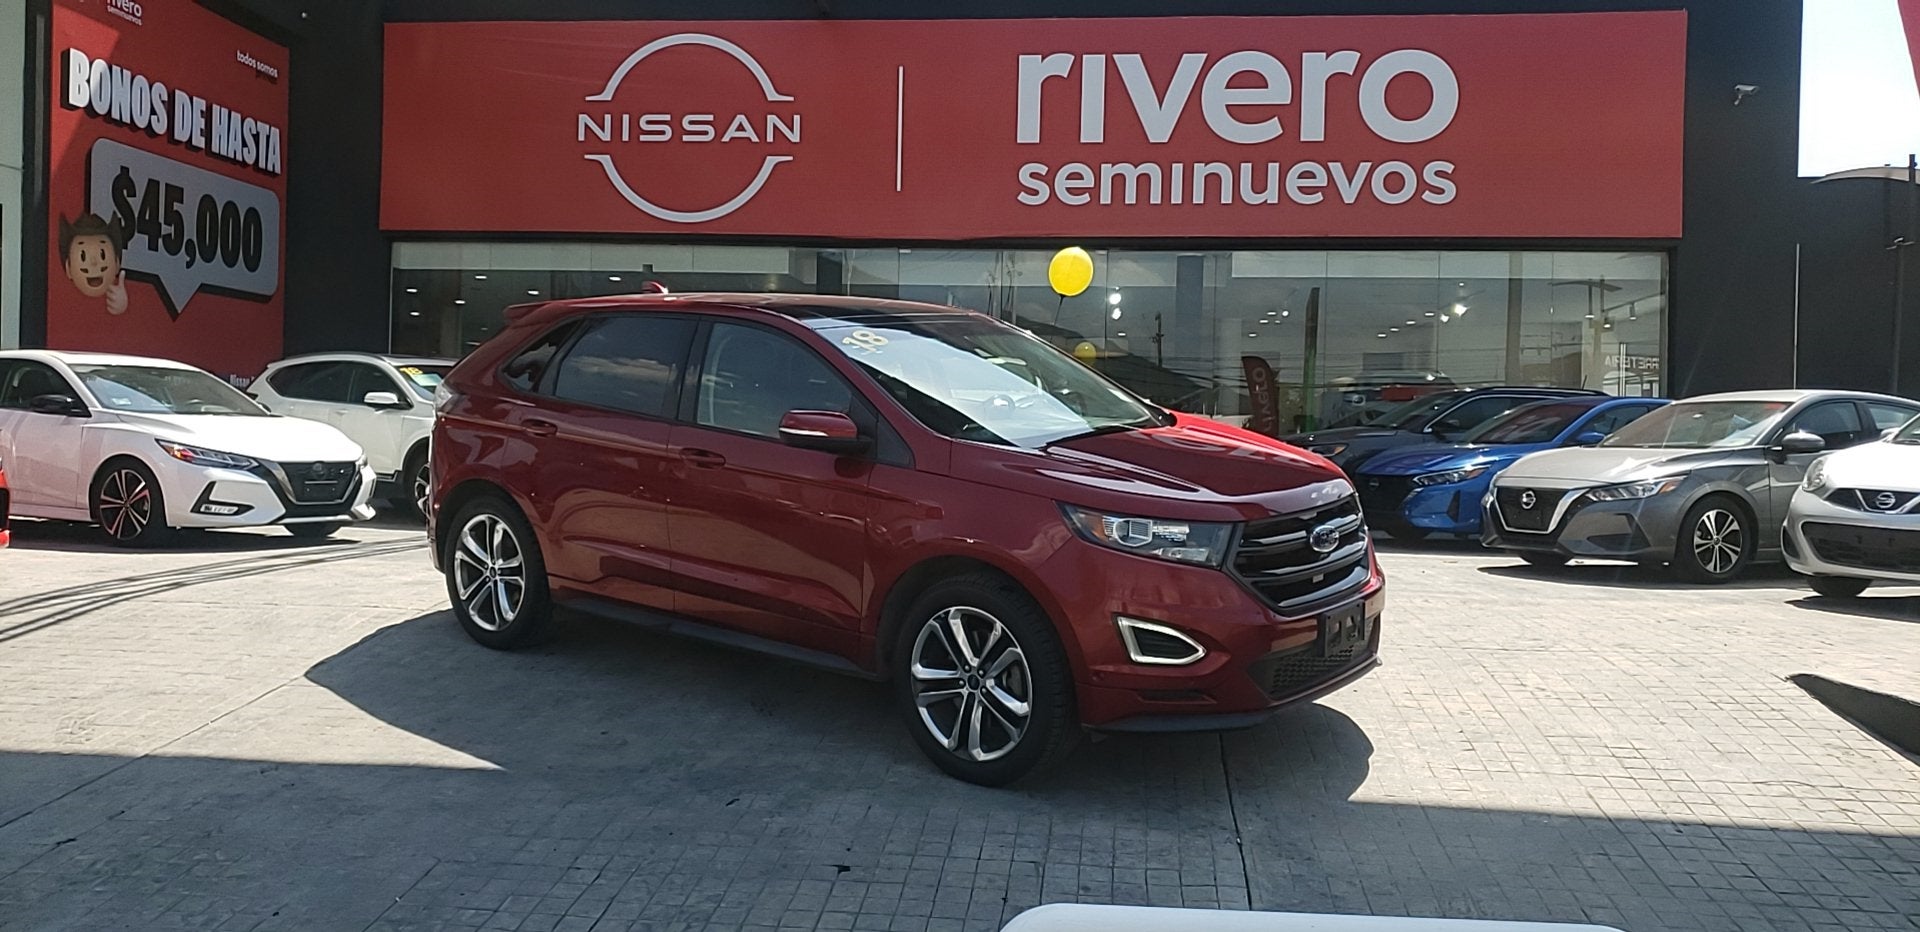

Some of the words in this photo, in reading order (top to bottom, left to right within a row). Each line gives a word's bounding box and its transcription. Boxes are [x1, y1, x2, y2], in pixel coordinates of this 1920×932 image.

[237, 50, 256, 68] todos
[257, 61, 278, 78] somos
[68, 48, 168, 135] BONOS
[174, 89, 206, 149] DE
[211, 104, 282, 175] HASTA
[1017, 49, 1460, 144] rivero
[577, 113, 801, 143] NISSAN
[1017, 159, 1457, 206] seminuevos
[111, 165, 263, 273] $45,000
[842, 330, 889, 352] 18
